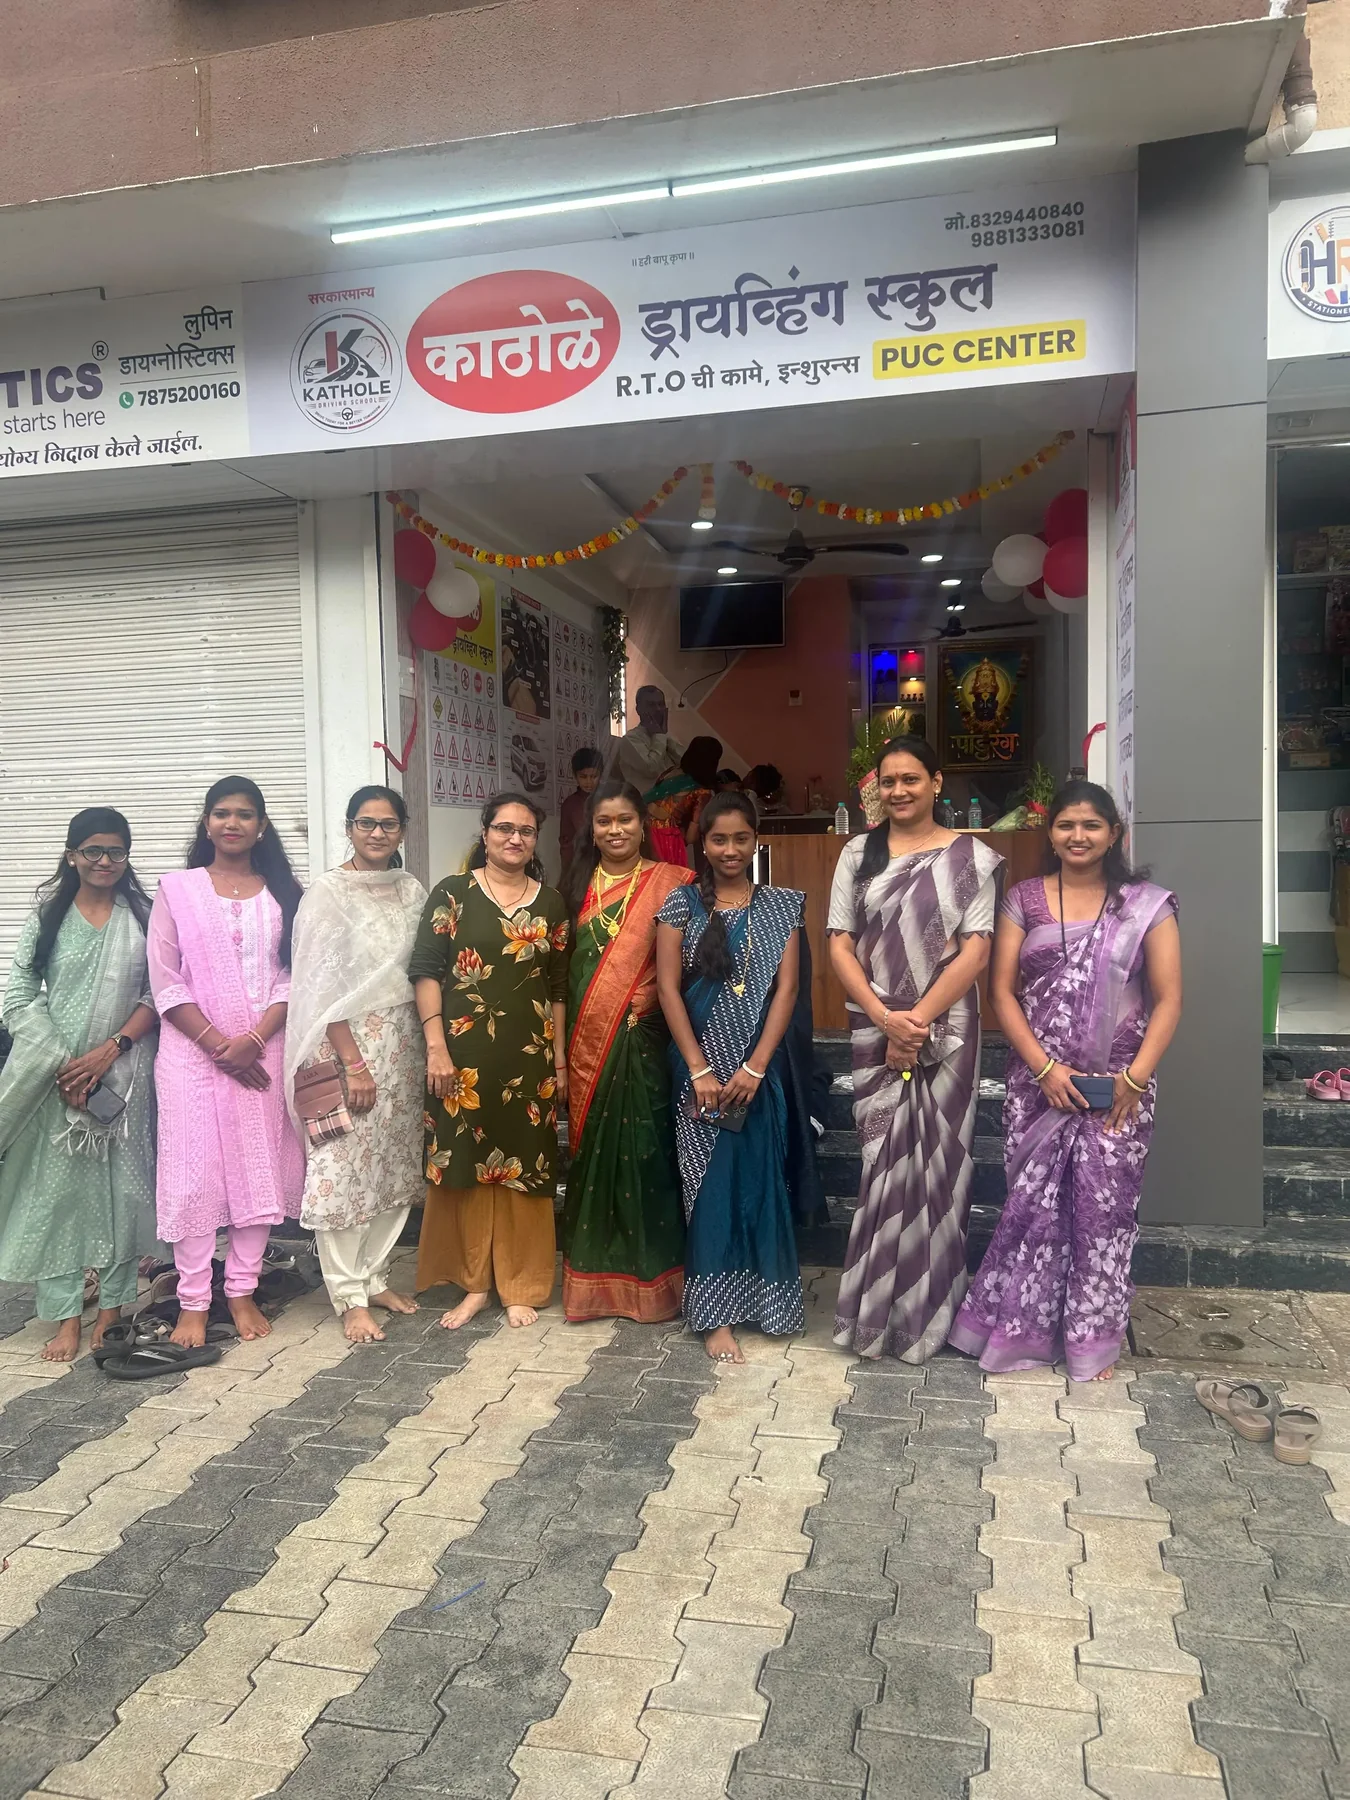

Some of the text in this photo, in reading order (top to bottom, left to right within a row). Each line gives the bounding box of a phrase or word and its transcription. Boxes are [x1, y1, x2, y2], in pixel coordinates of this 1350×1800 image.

[970, 219, 1085, 248] 9881333081
[308, 286, 376, 305] सरकारमान्य
[1307, 300, 1350, 315] STATIONE
[183, 305, 234, 340] लुपिन
[638, 262, 999, 361] ड्रायव्हिंग स्कुल
[422, 298, 605, 383] काठोळे
[881, 328, 1077, 372] PUC CENTER
[118, 342, 236, 376] डायग्नोस्टिक्स
[691, 364, 715, 389] ची
[777, 355, 861, 386] इन्शुरन्स
[137, 380, 241, 407] 7875200160
[303, 380, 391, 402] KATHOLE
[318, 397, 377, 409] DRIVING SCHOOL
[3, 408, 106, 435] starts here
[44, 442, 101, 464] निदान
[104, 435, 143, 459] केले
[146, 431, 203, 455] जाईल.
